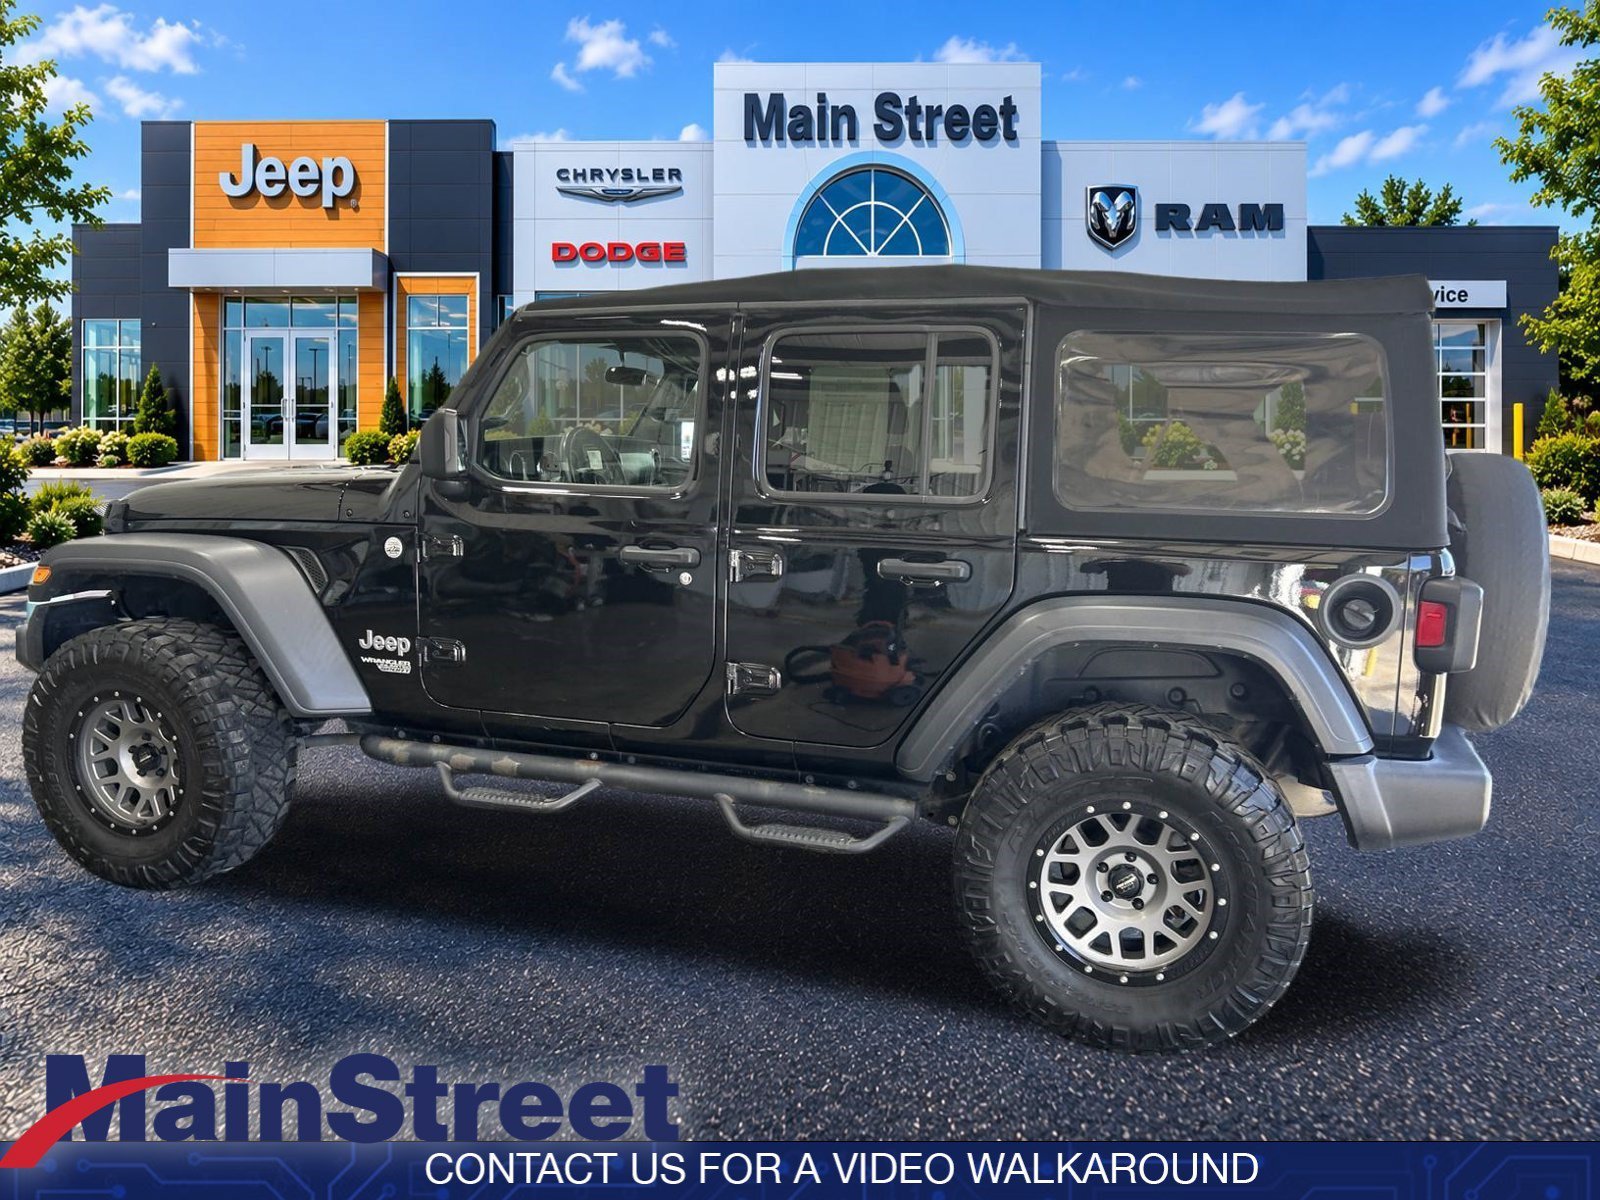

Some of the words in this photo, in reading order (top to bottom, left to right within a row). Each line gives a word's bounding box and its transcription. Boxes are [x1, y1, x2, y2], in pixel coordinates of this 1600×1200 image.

[743, 92, 857, 141] Main
[873, 91, 1018, 141] Street
[218, 143, 355, 208] Jeep
[556, 168, 683, 182] CHRYSLER
[1154, 203, 1284, 231] RAM
[551, 242, 686, 262] DODGE
[358, 629, 411, 657] Jeep
[360, 656, 411, 666] WRANGLER
